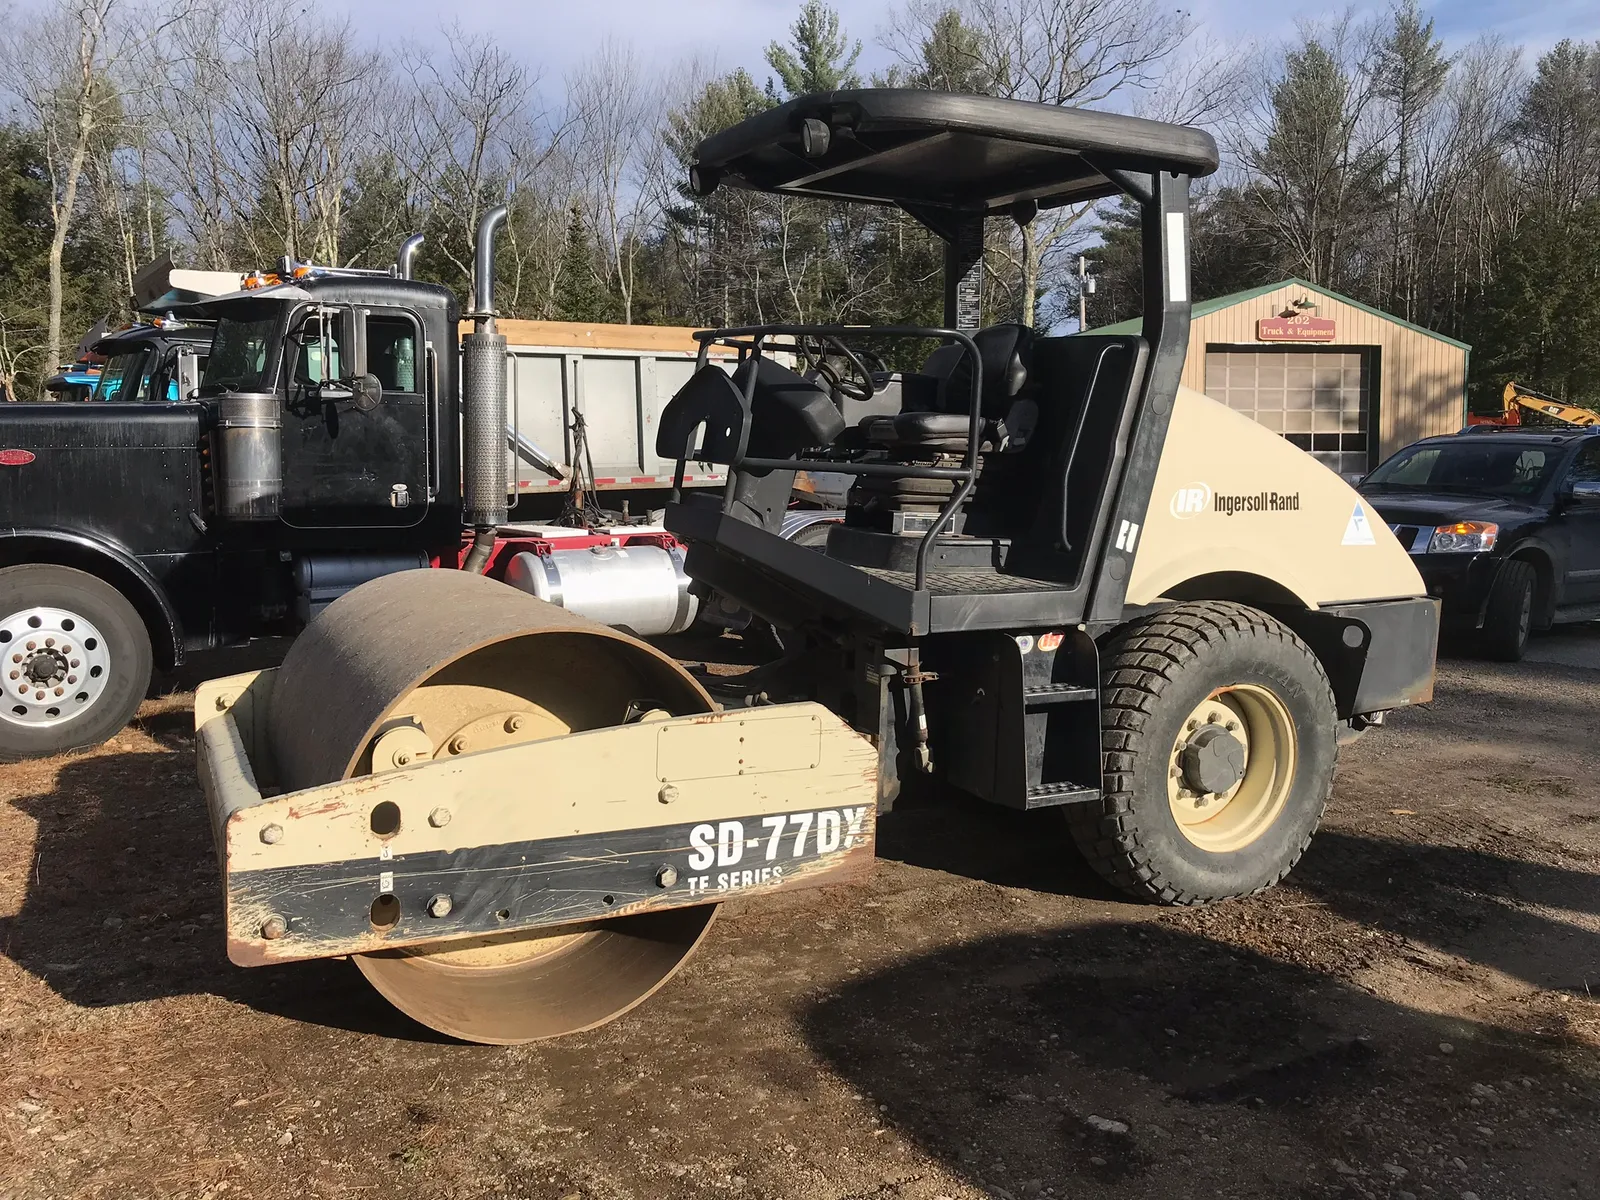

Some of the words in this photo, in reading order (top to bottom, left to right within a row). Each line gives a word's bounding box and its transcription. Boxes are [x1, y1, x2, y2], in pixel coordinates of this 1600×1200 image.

[1262, 326, 1284, 335] Truck
[1297, 327, 1334, 337] Equipment
[1287, 316, 1310, 324] 202
[1177, 489, 1204, 512] IR
[1214, 492, 1268, 516] Ingersoll
[688, 806, 867, 871] SD-77DX
[717, 865, 783, 893] SERIES
